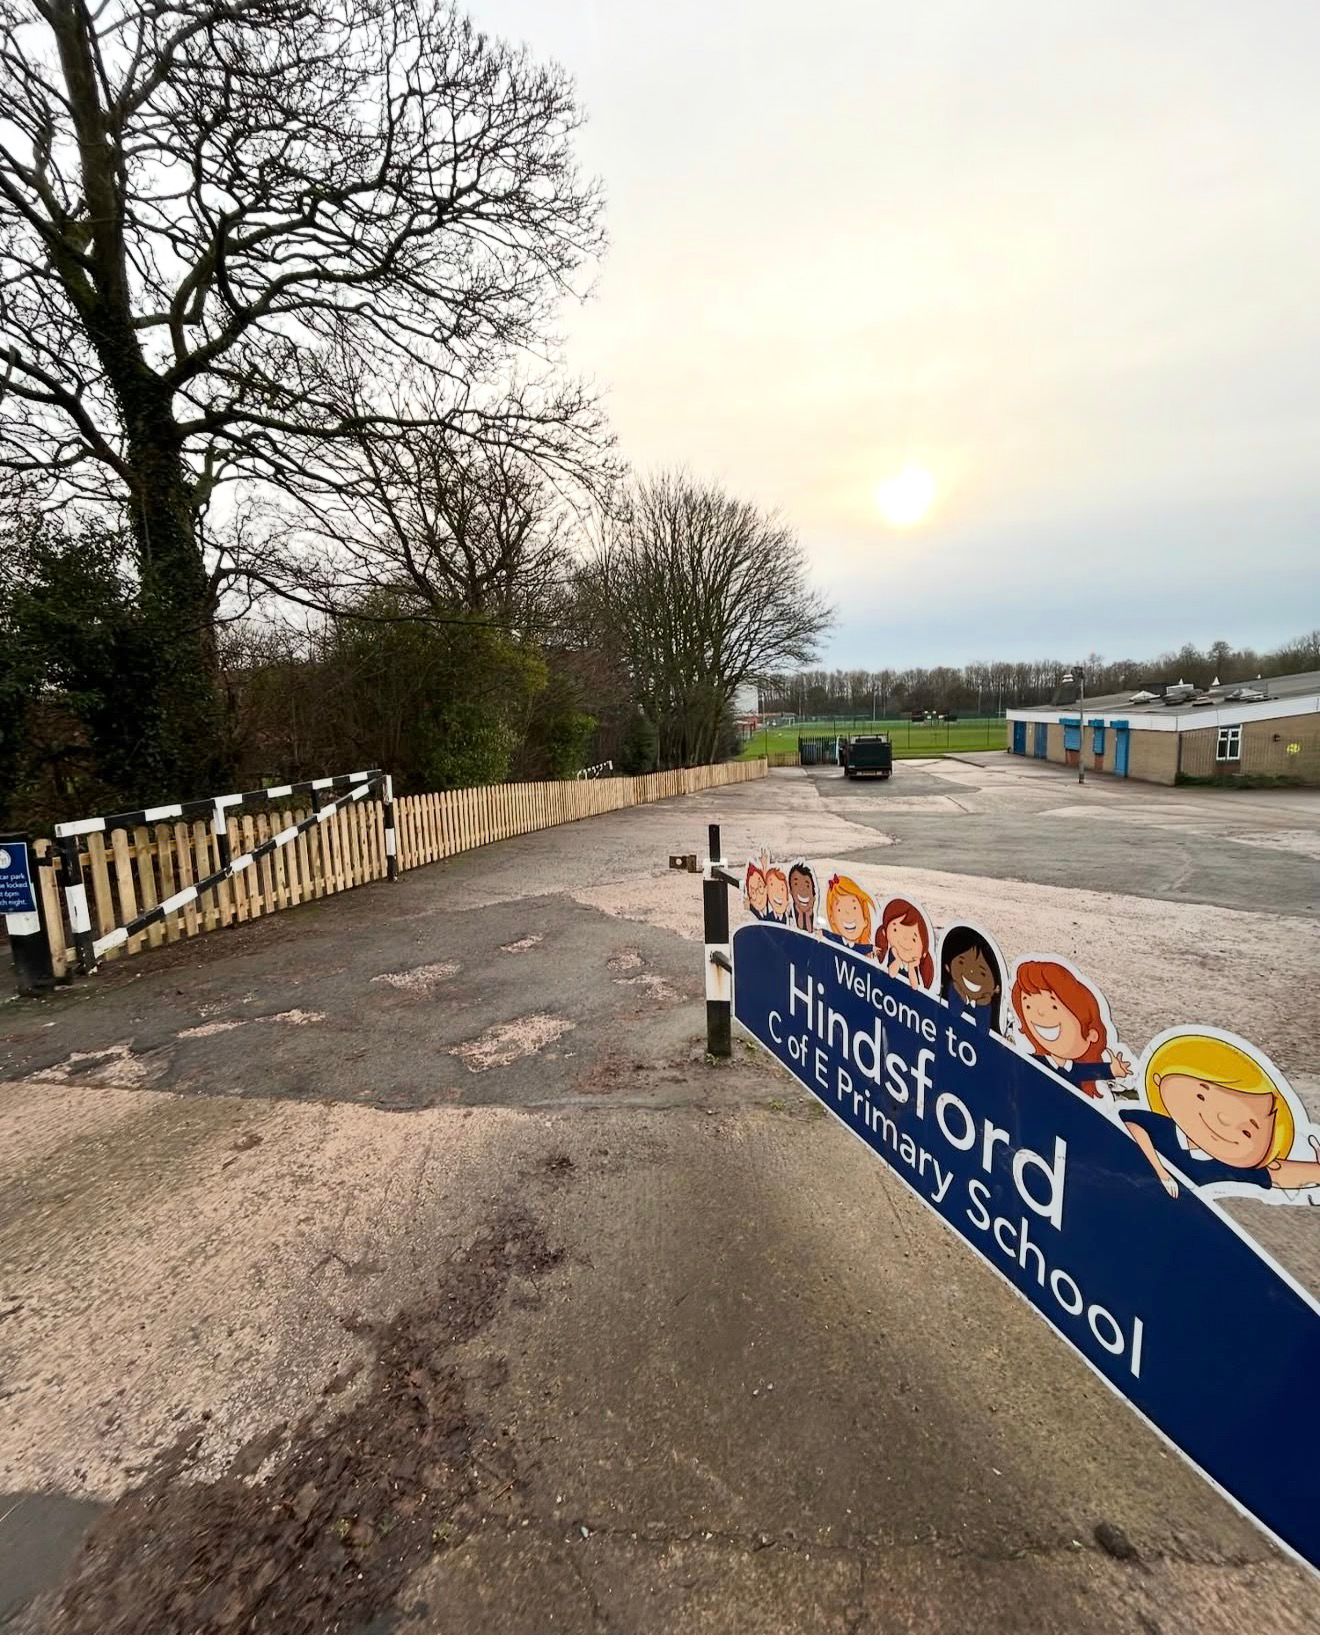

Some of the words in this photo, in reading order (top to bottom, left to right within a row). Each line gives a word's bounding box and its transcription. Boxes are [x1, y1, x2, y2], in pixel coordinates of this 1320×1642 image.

[10, 873, 25, 881] park
[790, 963, 1066, 1231] Hindsford
[835, 960, 936, 1042] Welcome
[946, 1027, 976, 1066] to
[769, 1011, 782, 1046] C
[788, 1032, 808, 1067] of
[816, 1047, 828, 1088] E
[838, 1066, 953, 1203] Primary
[966, 1179, 1143, 1378] School
